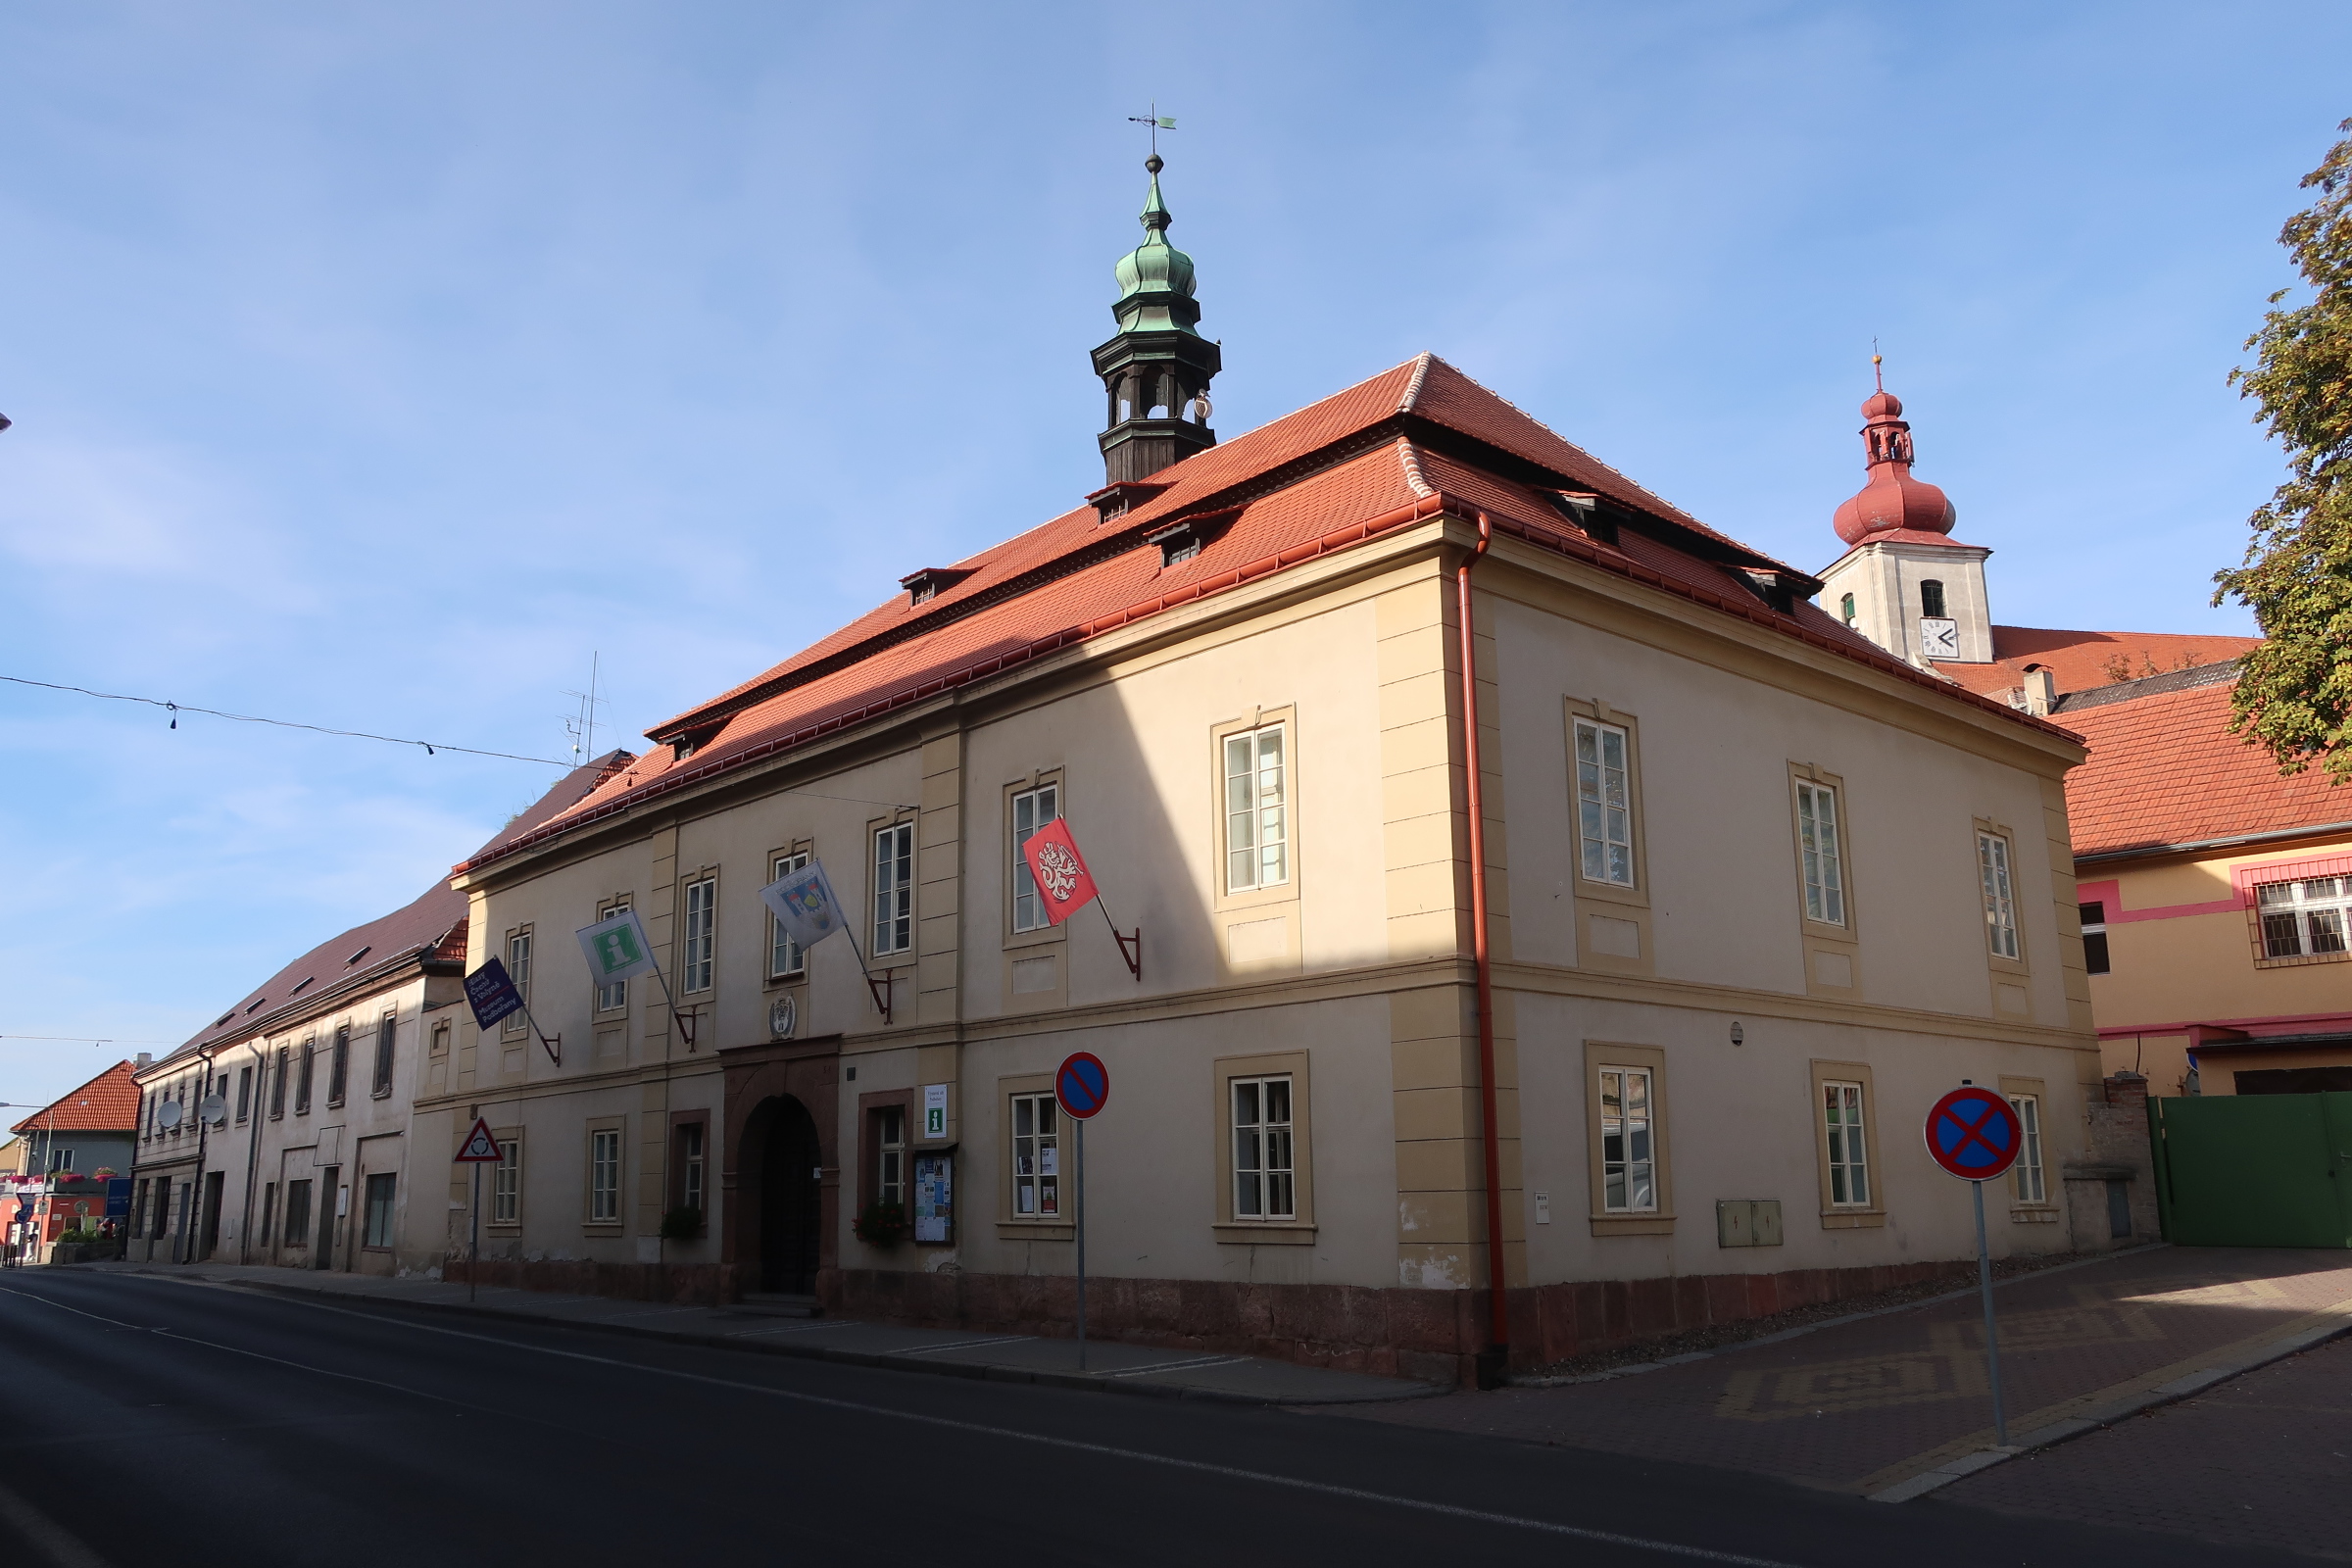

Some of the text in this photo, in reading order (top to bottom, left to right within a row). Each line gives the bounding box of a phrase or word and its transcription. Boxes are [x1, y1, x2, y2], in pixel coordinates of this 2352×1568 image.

[467, 972, 485, 986] Hlasy
[478, 996, 504, 1015] Muzeum
[482, 998, 516, 1022] Podbořany
